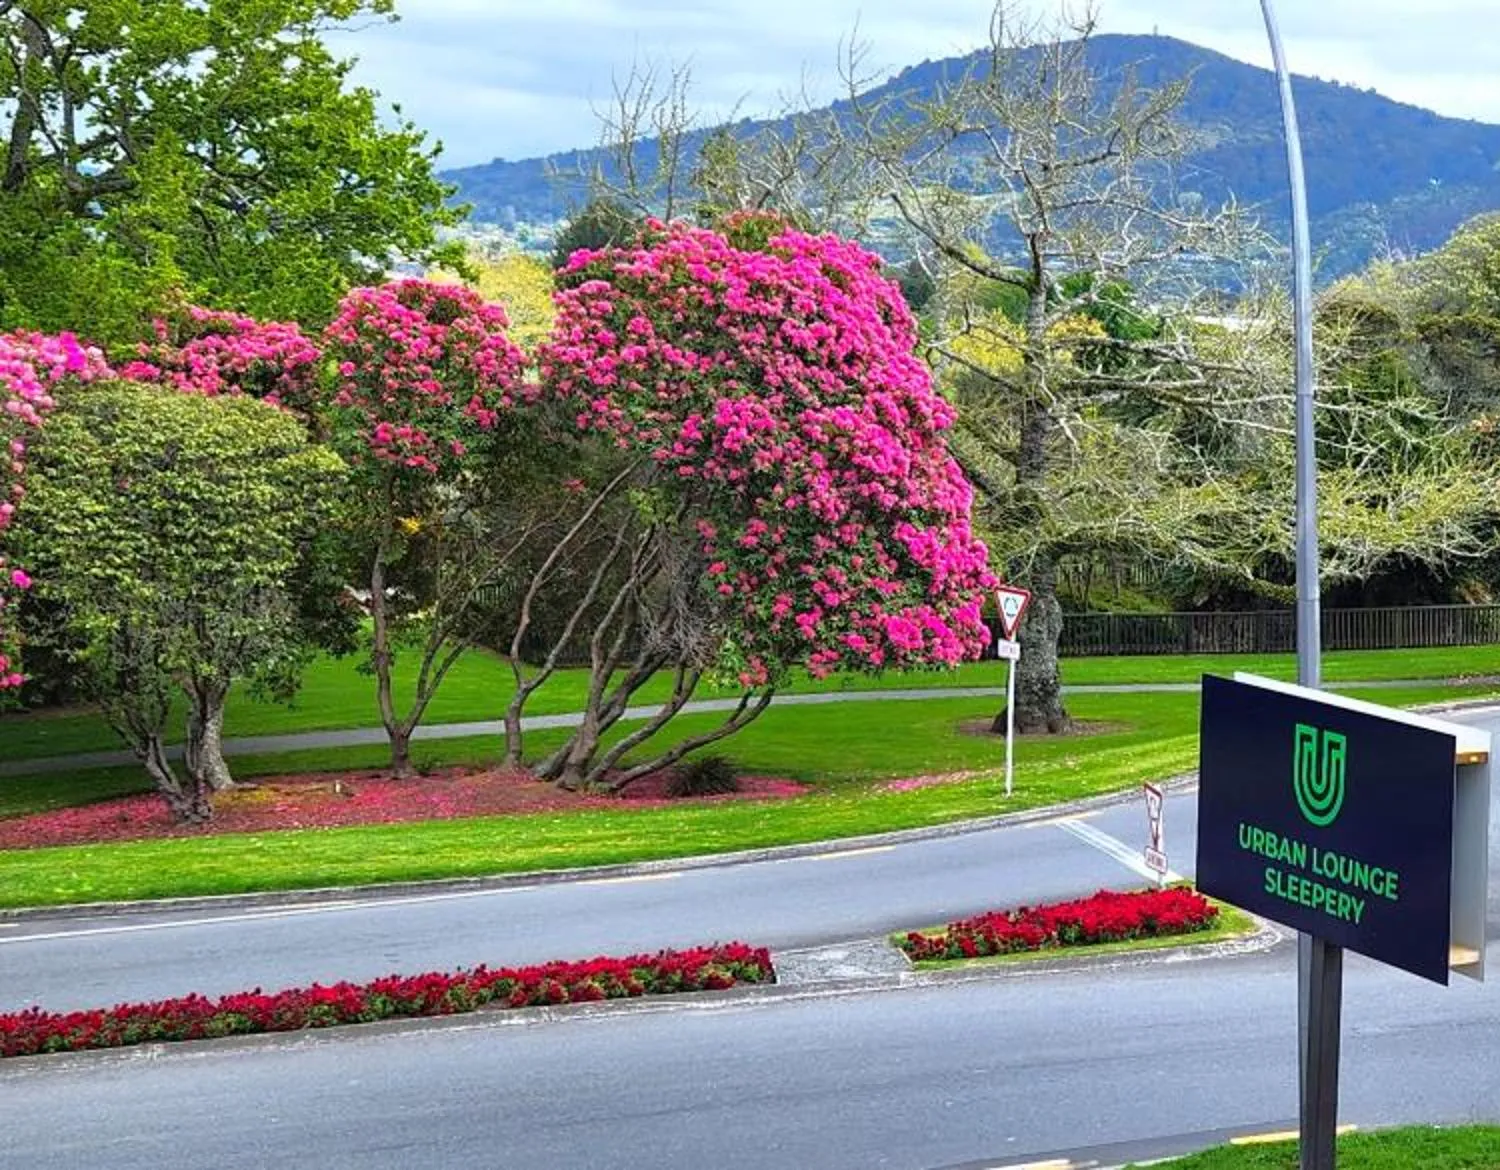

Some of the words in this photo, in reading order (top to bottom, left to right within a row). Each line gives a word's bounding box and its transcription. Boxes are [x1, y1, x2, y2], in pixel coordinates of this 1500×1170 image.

[1239, 823, 1307, 870] URBAN
[1312, 848, 1399, 900] LOUNGE
[1264, 867, 1365, 924] SLEEPERY
